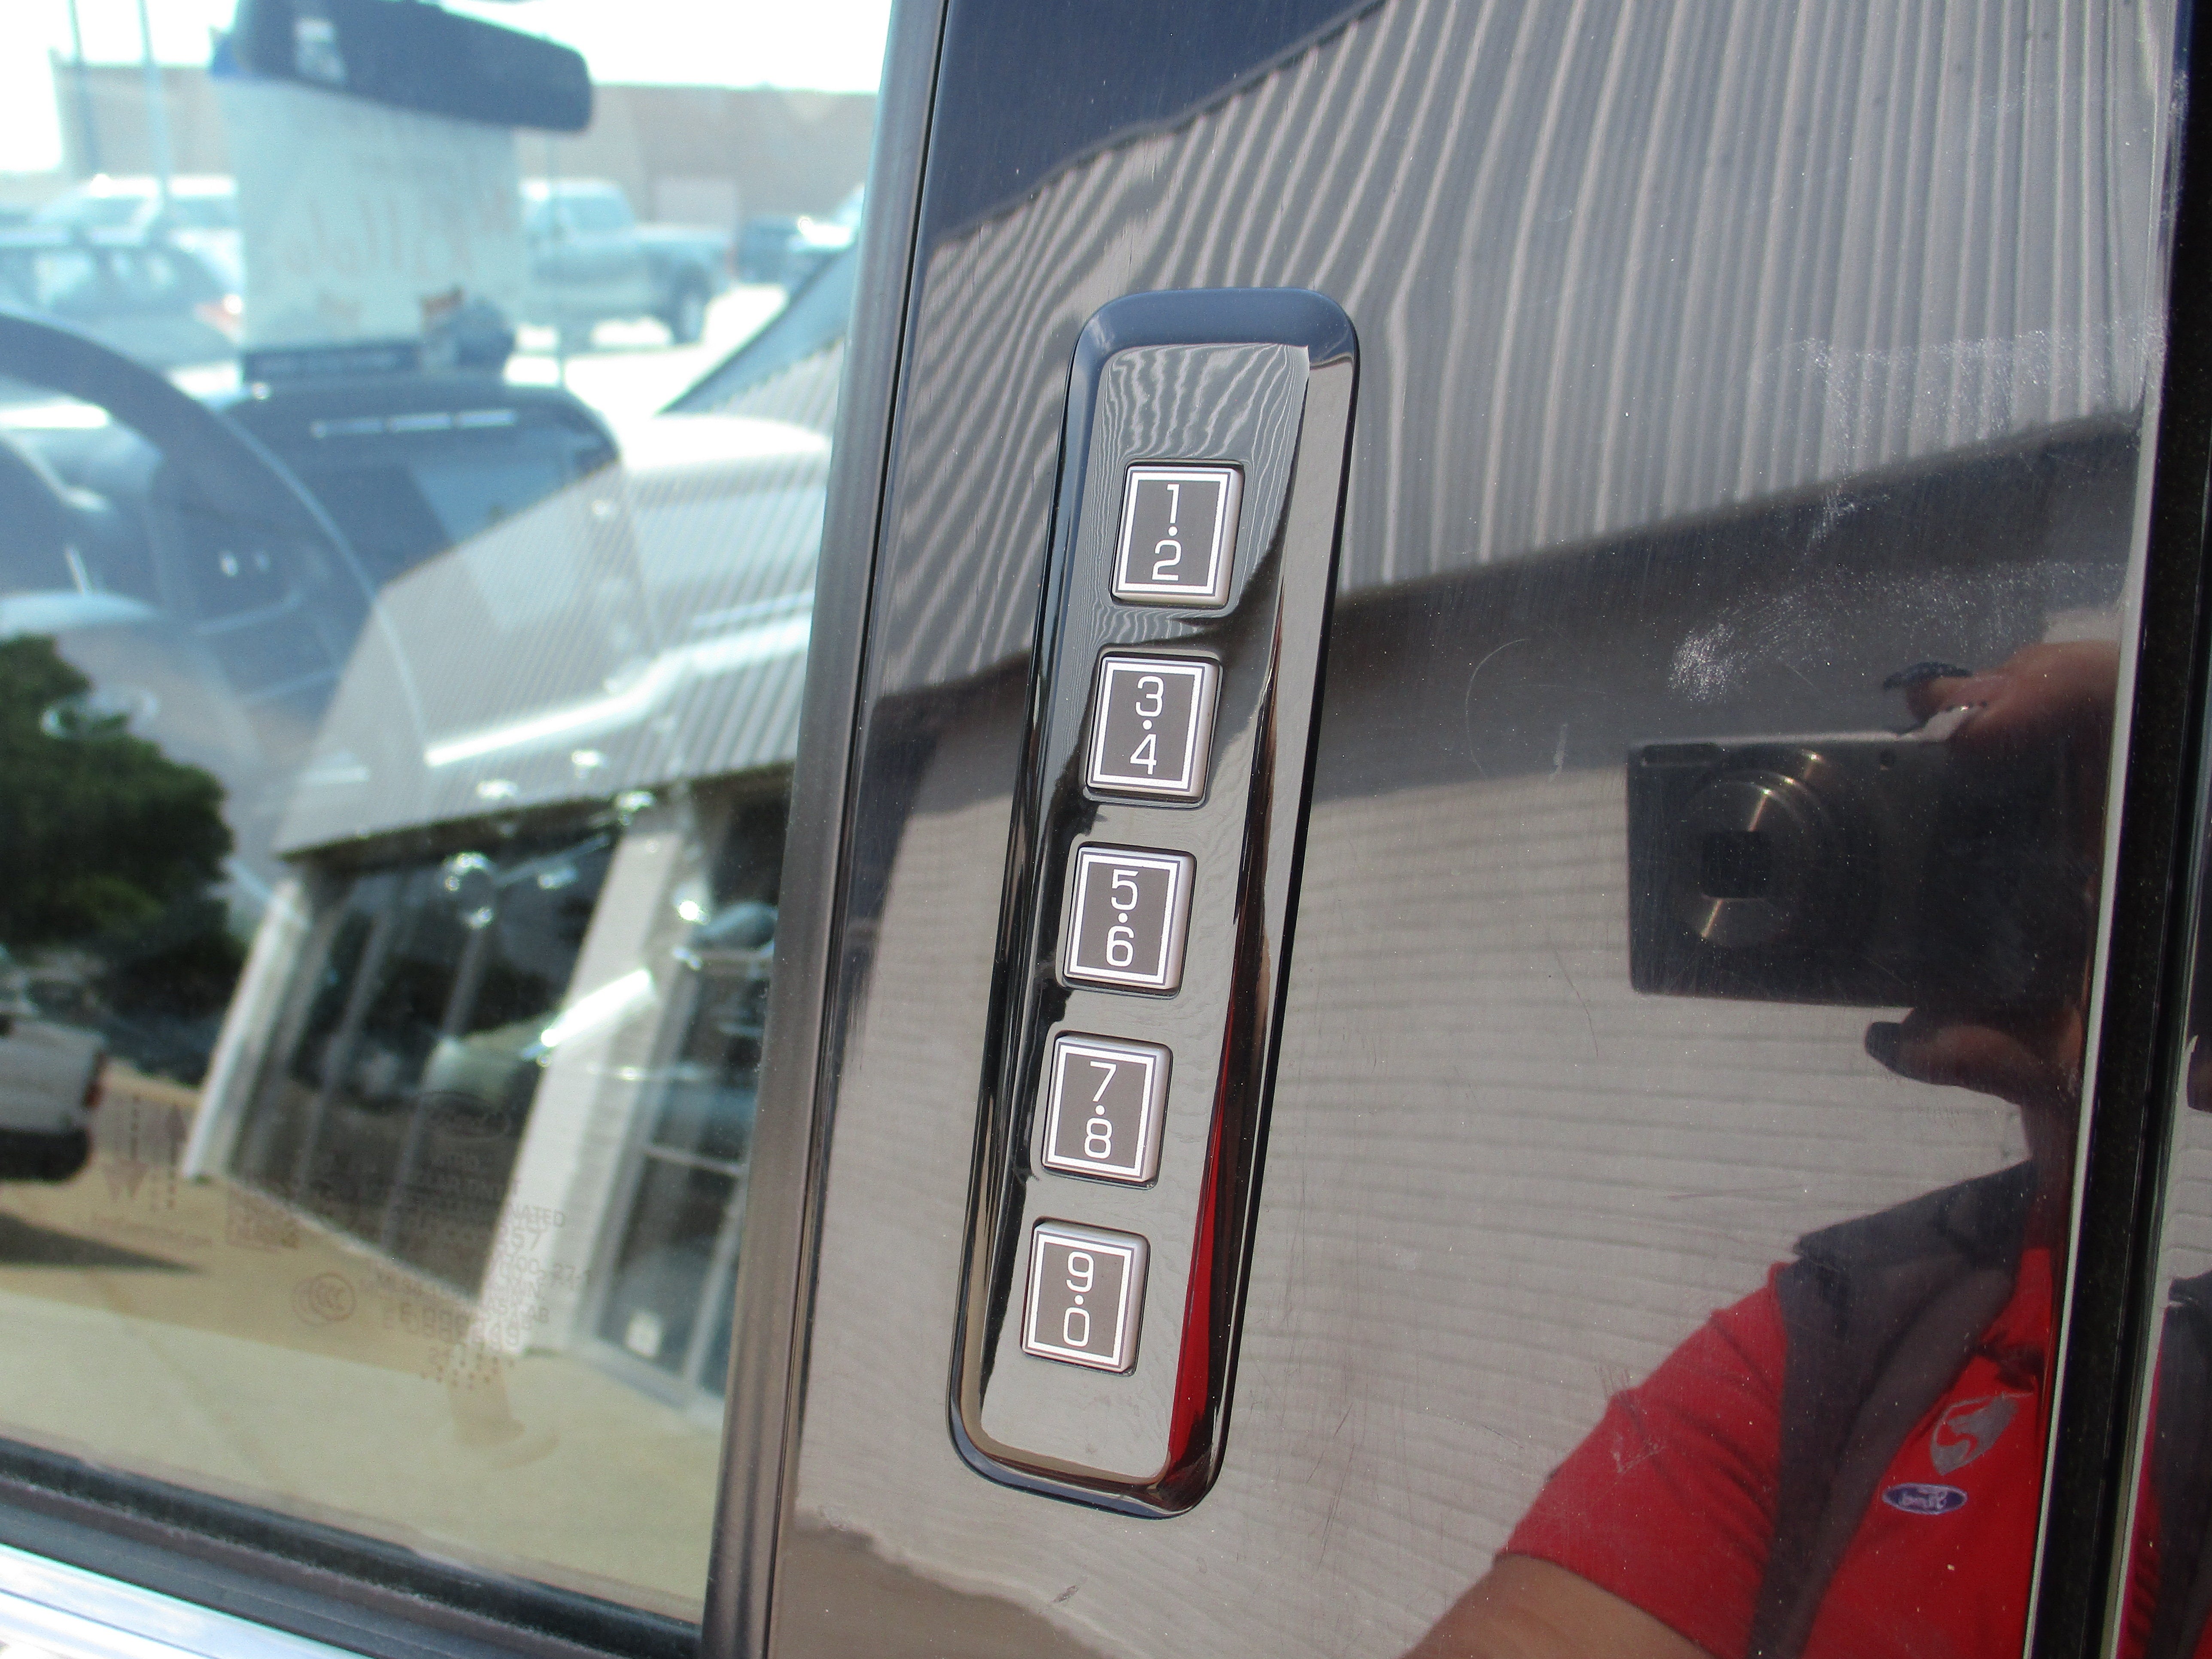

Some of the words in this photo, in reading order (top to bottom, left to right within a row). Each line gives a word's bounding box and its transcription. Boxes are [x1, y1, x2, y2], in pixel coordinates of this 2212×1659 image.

[1167, 483, 1180, 524] 1
[1152, 540, 1182, 581] 2
[1136, 676, 1164, 717] 3
[1130, 733, 1157, 775] 4
[1111, 869, 1139, 910] 5
[1106, 925, 1134, 967] 6
[1090, 1061, 1117, 1102] 7
[1084, 1118, 1112, 1159] 8
[1066, 1251, 1094, 1292] 9
[1063, 1307, 1090, 1347] 0
